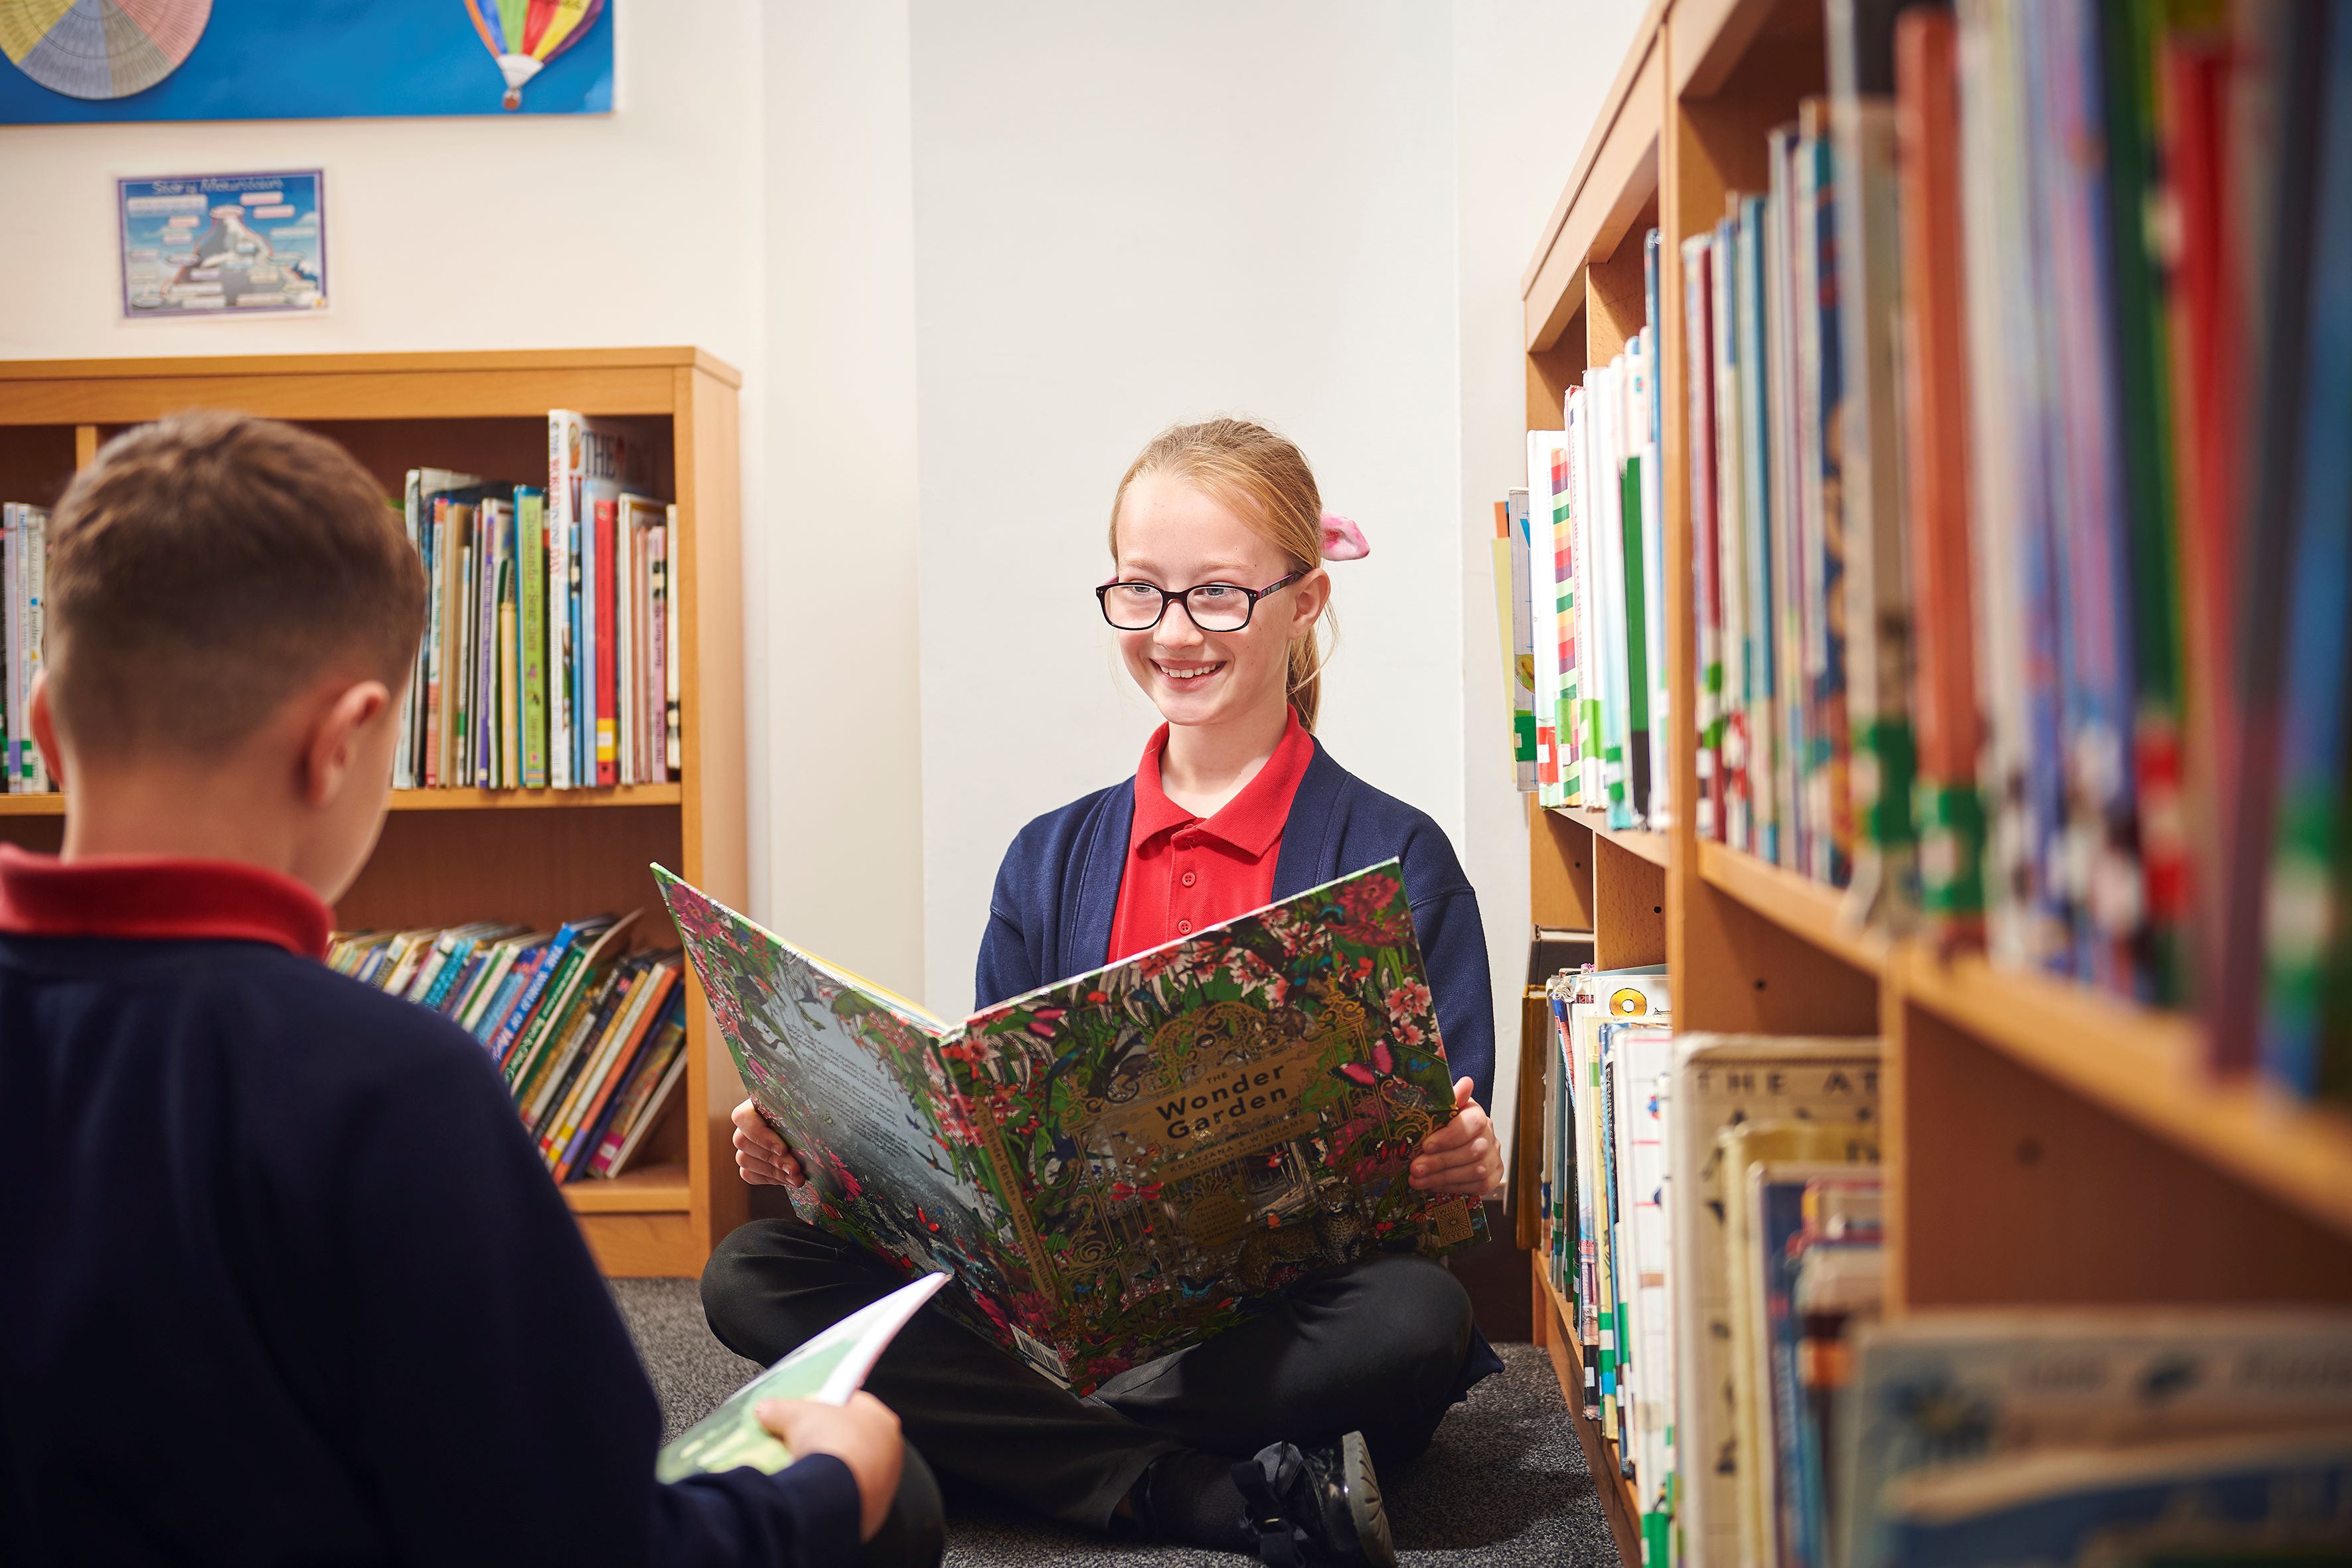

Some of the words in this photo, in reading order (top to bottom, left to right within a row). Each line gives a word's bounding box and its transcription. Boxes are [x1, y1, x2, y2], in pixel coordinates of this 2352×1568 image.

[152, 181, 198, 195] Story
[200, 178, 283, 192] Mountain
[582, 432, 616, 477] THE
[1156, 1064, 1285, 1121] Wonder
[1206, 1071, 1228, 1085] THE
[1697, 1071, 1785, 1093] THE
[1167, 1086, 1287, 1139] Garden
[987, 1130, 1004, 1161] Wonder
[1000, 1164, 1016, 1194] Garden
[1170, 1145, 1233, 1173] KRISTJANA
[1249, 1117, 1306, 1143] WILLIAMS
[1438, 1202, 1462, 1215] WIDE
[1018, 1214, 1037, 1252] KRISTJANA
[1036, 1259, 1053, 1293] WILLIAMS
[1445, 1229, 1469, 1243] EYED
